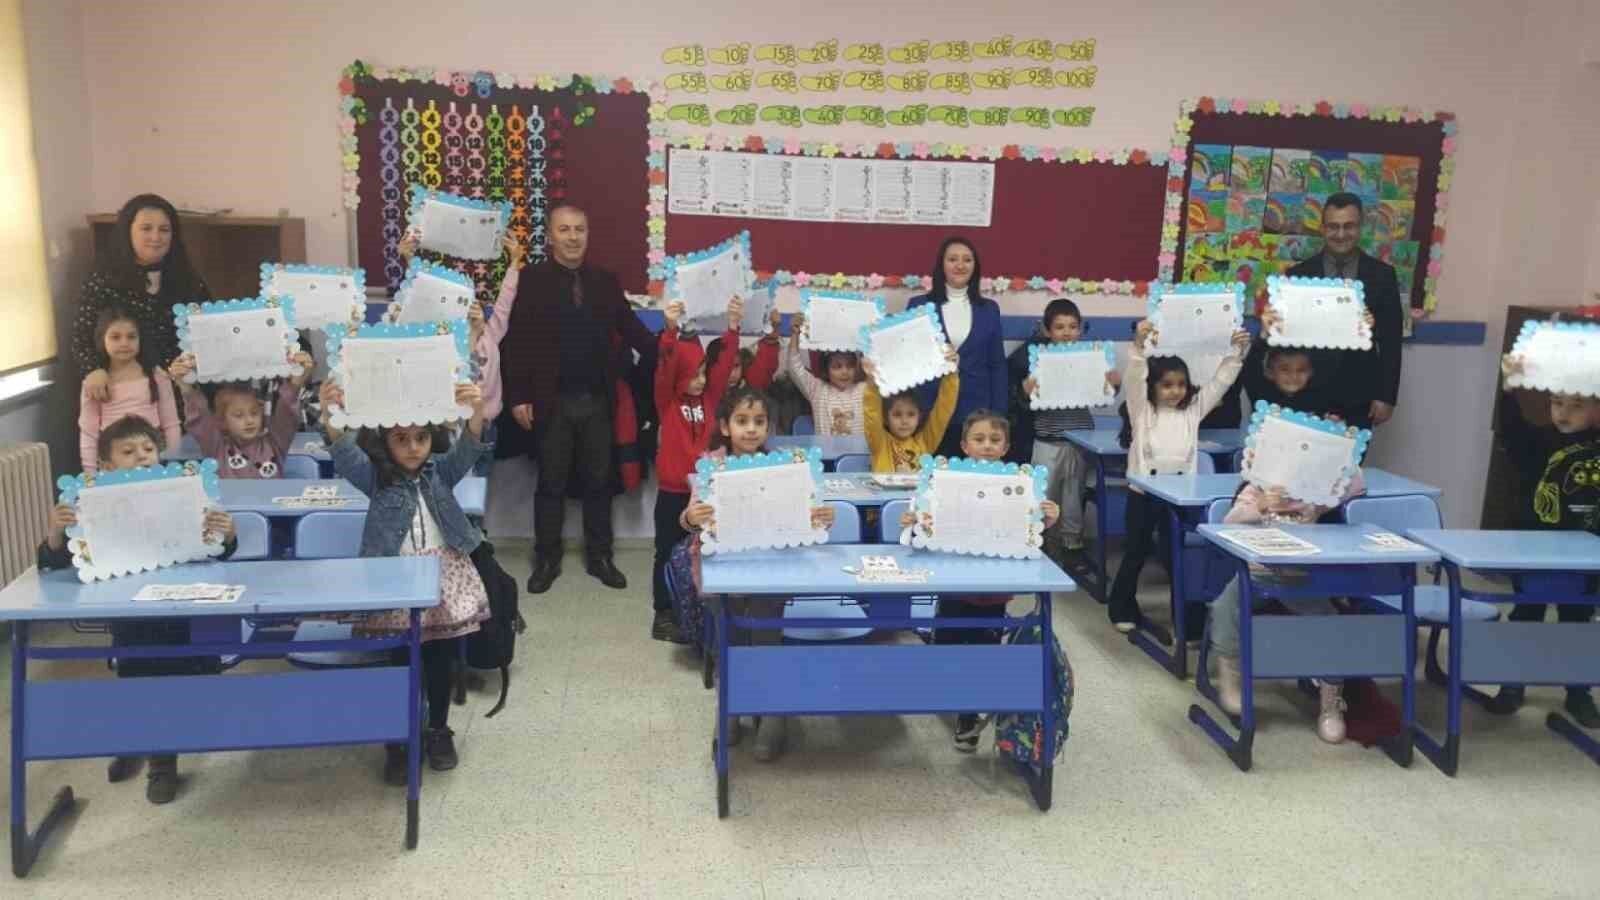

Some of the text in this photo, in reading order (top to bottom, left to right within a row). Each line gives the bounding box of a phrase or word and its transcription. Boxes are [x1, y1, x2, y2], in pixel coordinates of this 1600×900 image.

[726, 49, 738, 62] 10
[773, 48, 786, 60] 15
[812, 46, 829, 61] 20
[859, 46, 876, 60] 25
[904, 47, 918, 62] 30
[946, 44, 961, 57] 35
[986, 42, 1003, 57] 40
[1026, 42, 1044, 56] 45
[1070, 45, 1088, 58] 50
[680, 70, 1087, 90] 55 60 65 70 75 80 85 90 95 100
[385, 110, 394, 123] 2
[406, 112, 415, 124] 3
[688, 107, 1085, 124] 10 20 30 40 50 60 70 80 90 100
[470, 117, 478, 128] 6
[490, 118, 500, 130] 7
[512, 119, 520, 130] 8
[532, 118, 540, 130] 9
[384, 130, 393, 143] 4
[407, 131, 415, 144] 6
[468, 138, 480, 149] 12
[490, 138, 502, 148] 14
[530, 139, 543, 150] 18
[424, 113, 438, 186] 4 8 12 16
[446, 115, 462, 186] 5 10 15 20
[386, 150, 394, 162] 6
[407, 151, 415, 164] 9
[470, 158, 481, 168] 18
[530, 158, 544, 168] 27
[386, 168, 394, 180] 8
[405, 171, 420, 182] 12
[469, 176, 484, 186] 24
[530, 177, 545, 188] 36
[384, 188, 398, 200] 10
